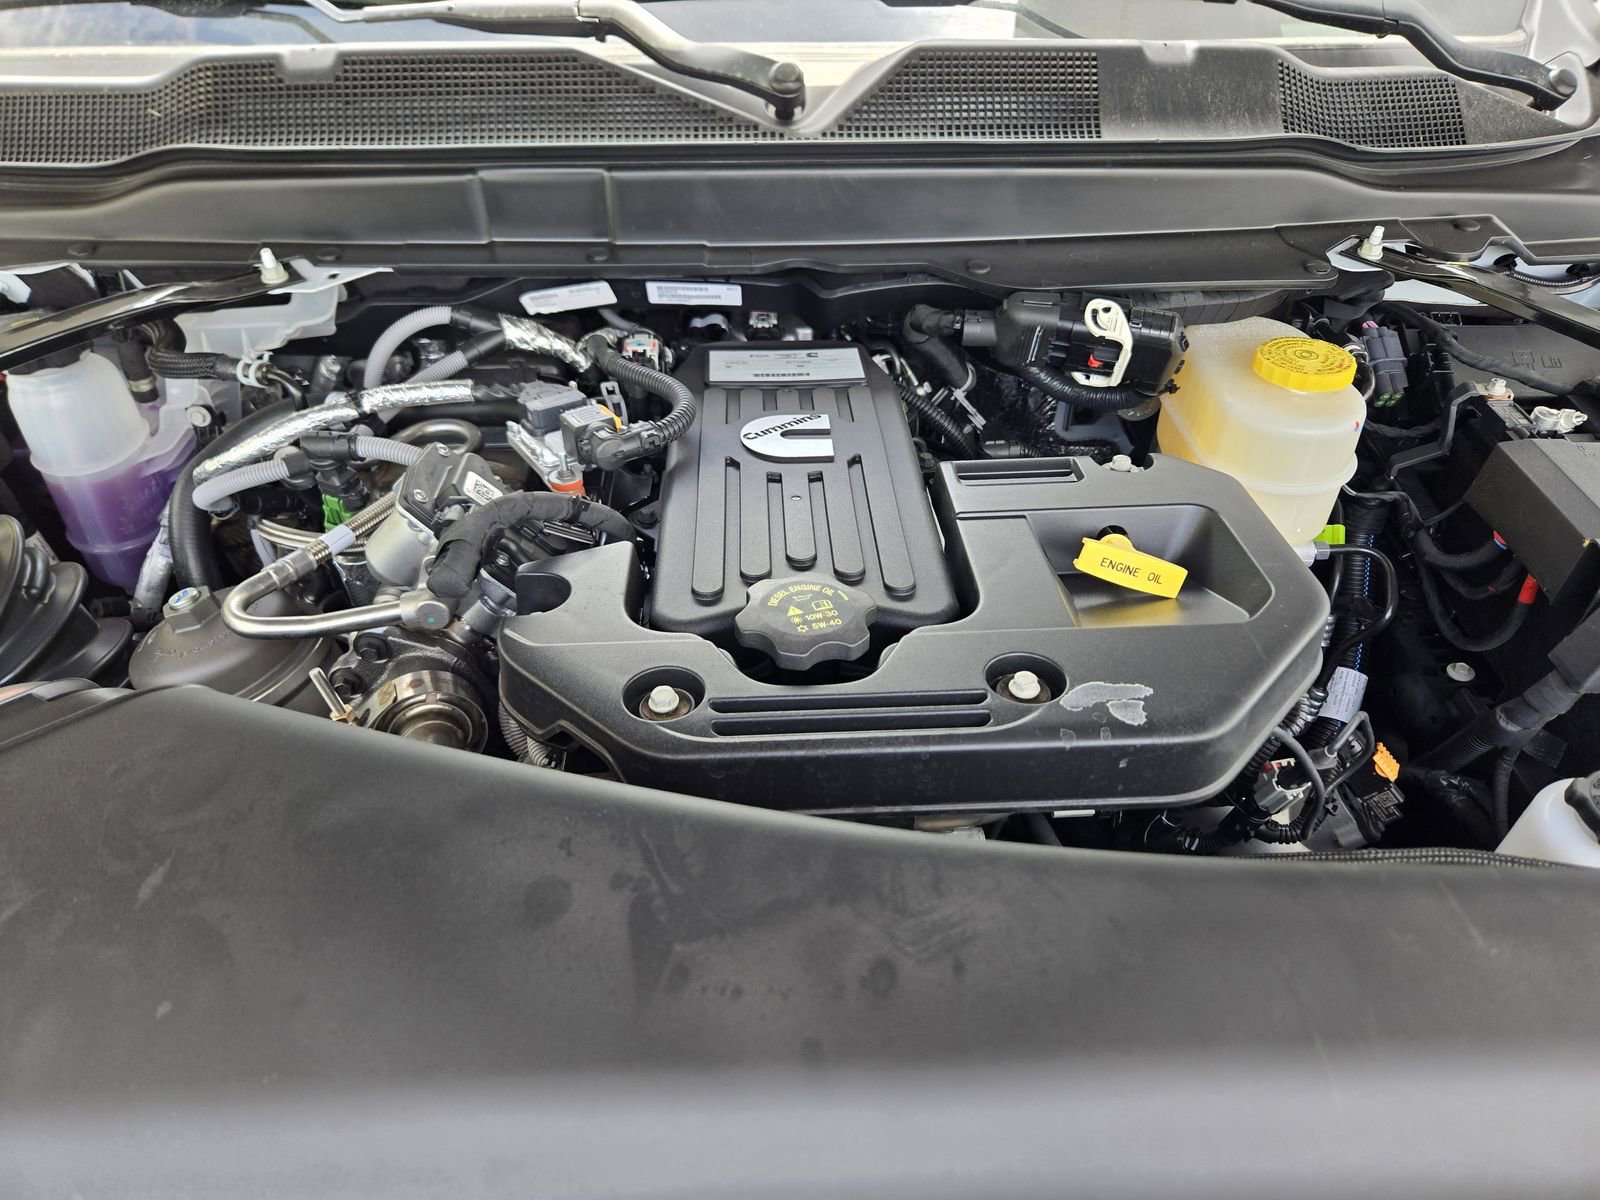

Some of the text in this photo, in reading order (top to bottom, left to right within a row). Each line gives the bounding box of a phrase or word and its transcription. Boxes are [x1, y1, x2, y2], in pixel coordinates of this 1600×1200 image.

[743, 414, 821, 440] Cummins
[1100, 557, 1163, 584] ENGINE OIL
[768, 584, 835, 607] DIESEL ENGINE OIL
[804, 609, 838, 622] 10W-30
[811, 618, 842, 630] 5W-40
